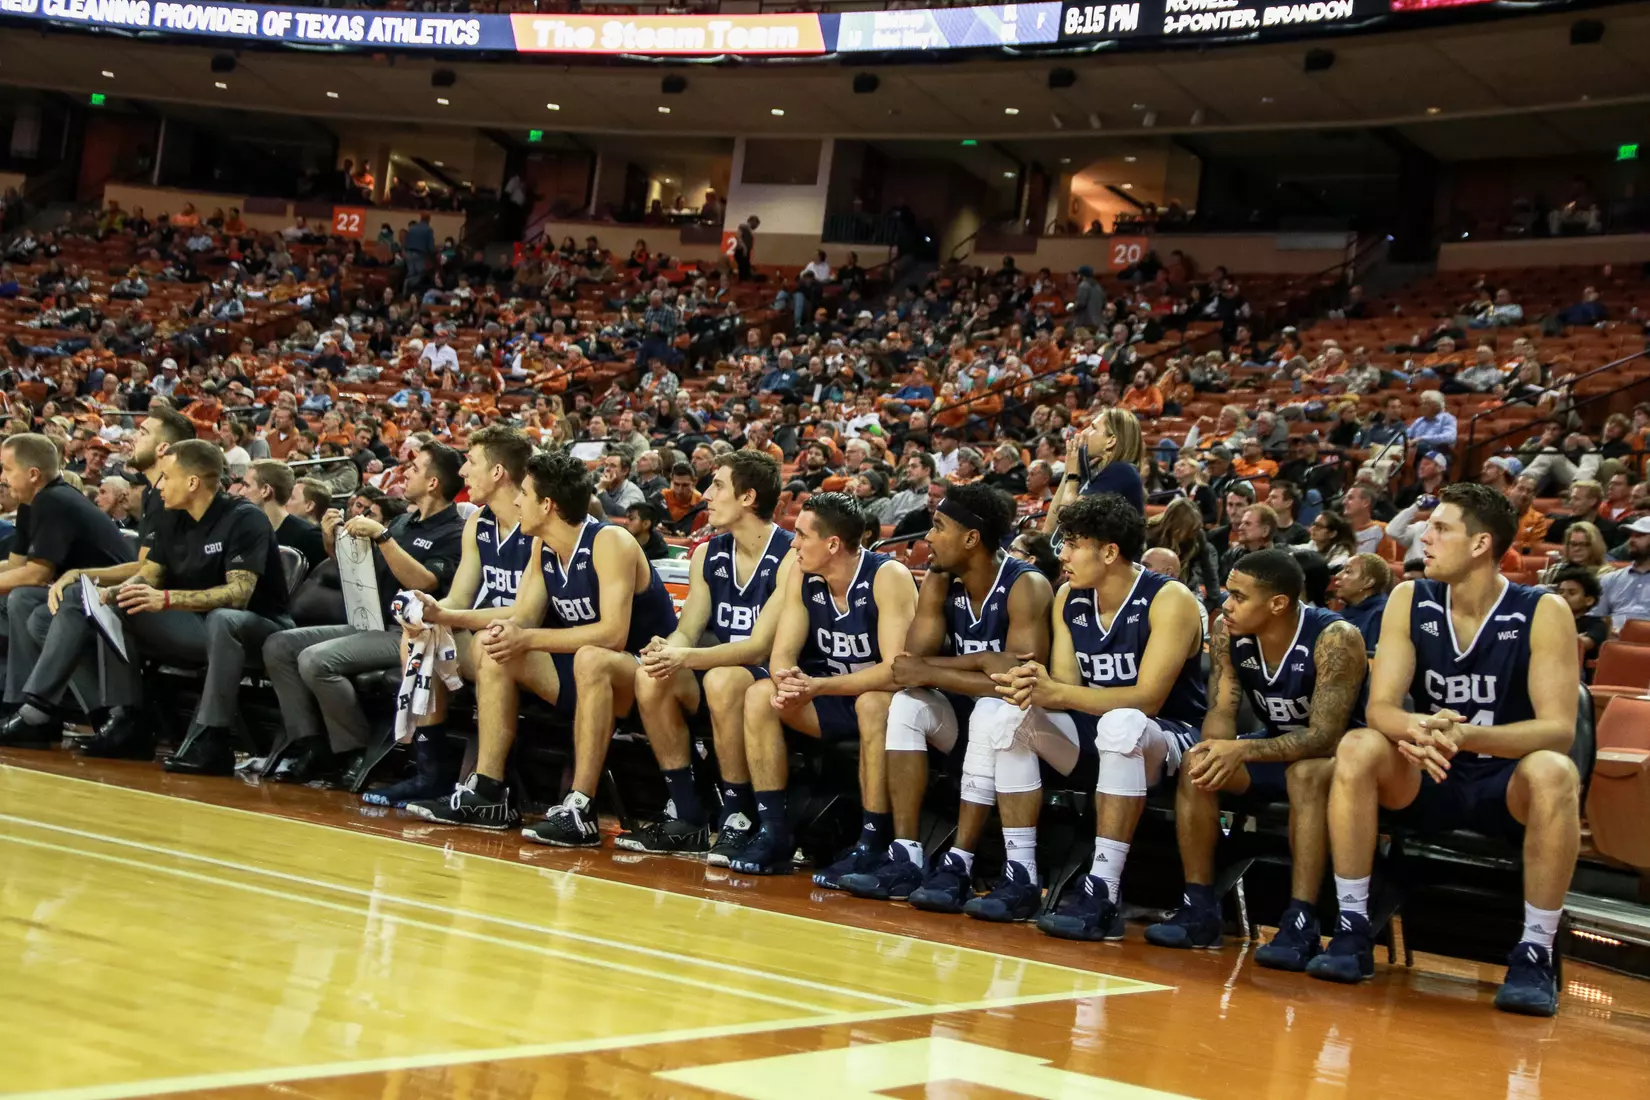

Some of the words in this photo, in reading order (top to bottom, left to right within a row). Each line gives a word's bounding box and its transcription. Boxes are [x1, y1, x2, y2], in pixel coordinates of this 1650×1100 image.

[42, 0, 150, 26] CLEANING
[153, 2, 259, 35] PROVIDER
[262, 11, 293, 37] OF
[294, 12, 365, 41] TEXAS
[366, 16, 481, 46] ATHLETICS
[1064, 6, 1106, 34] 8:15
[1107, 3, 1141, 33] PM
[1263, 1, 1354, 27] BRANDON
[532, 20, 595, 48] The
[600, 20, 706, 49] Steam
[708, 21, 799, 49] Team
[336, 213, 360, 232] 22
[1113, 244, 1141, 264] 20
[204, 541, 223, 554] CBU
[413, 538, 433, 550] CBU
[482, 565, 523, 594] CBU
[551, 595, 597, 622] CBU
[1126, 613, 1140, 624] WAC
[817, 627, 872, 657] CBU
[1497, 629, 1519, 640] WAC
[1075, 651, 1138, 680] CBU
[1240, 661, 1260, 671] adidas
[1425, 669, 1497, 704] CBU
[1253, 689, 1311, 722] CBU
